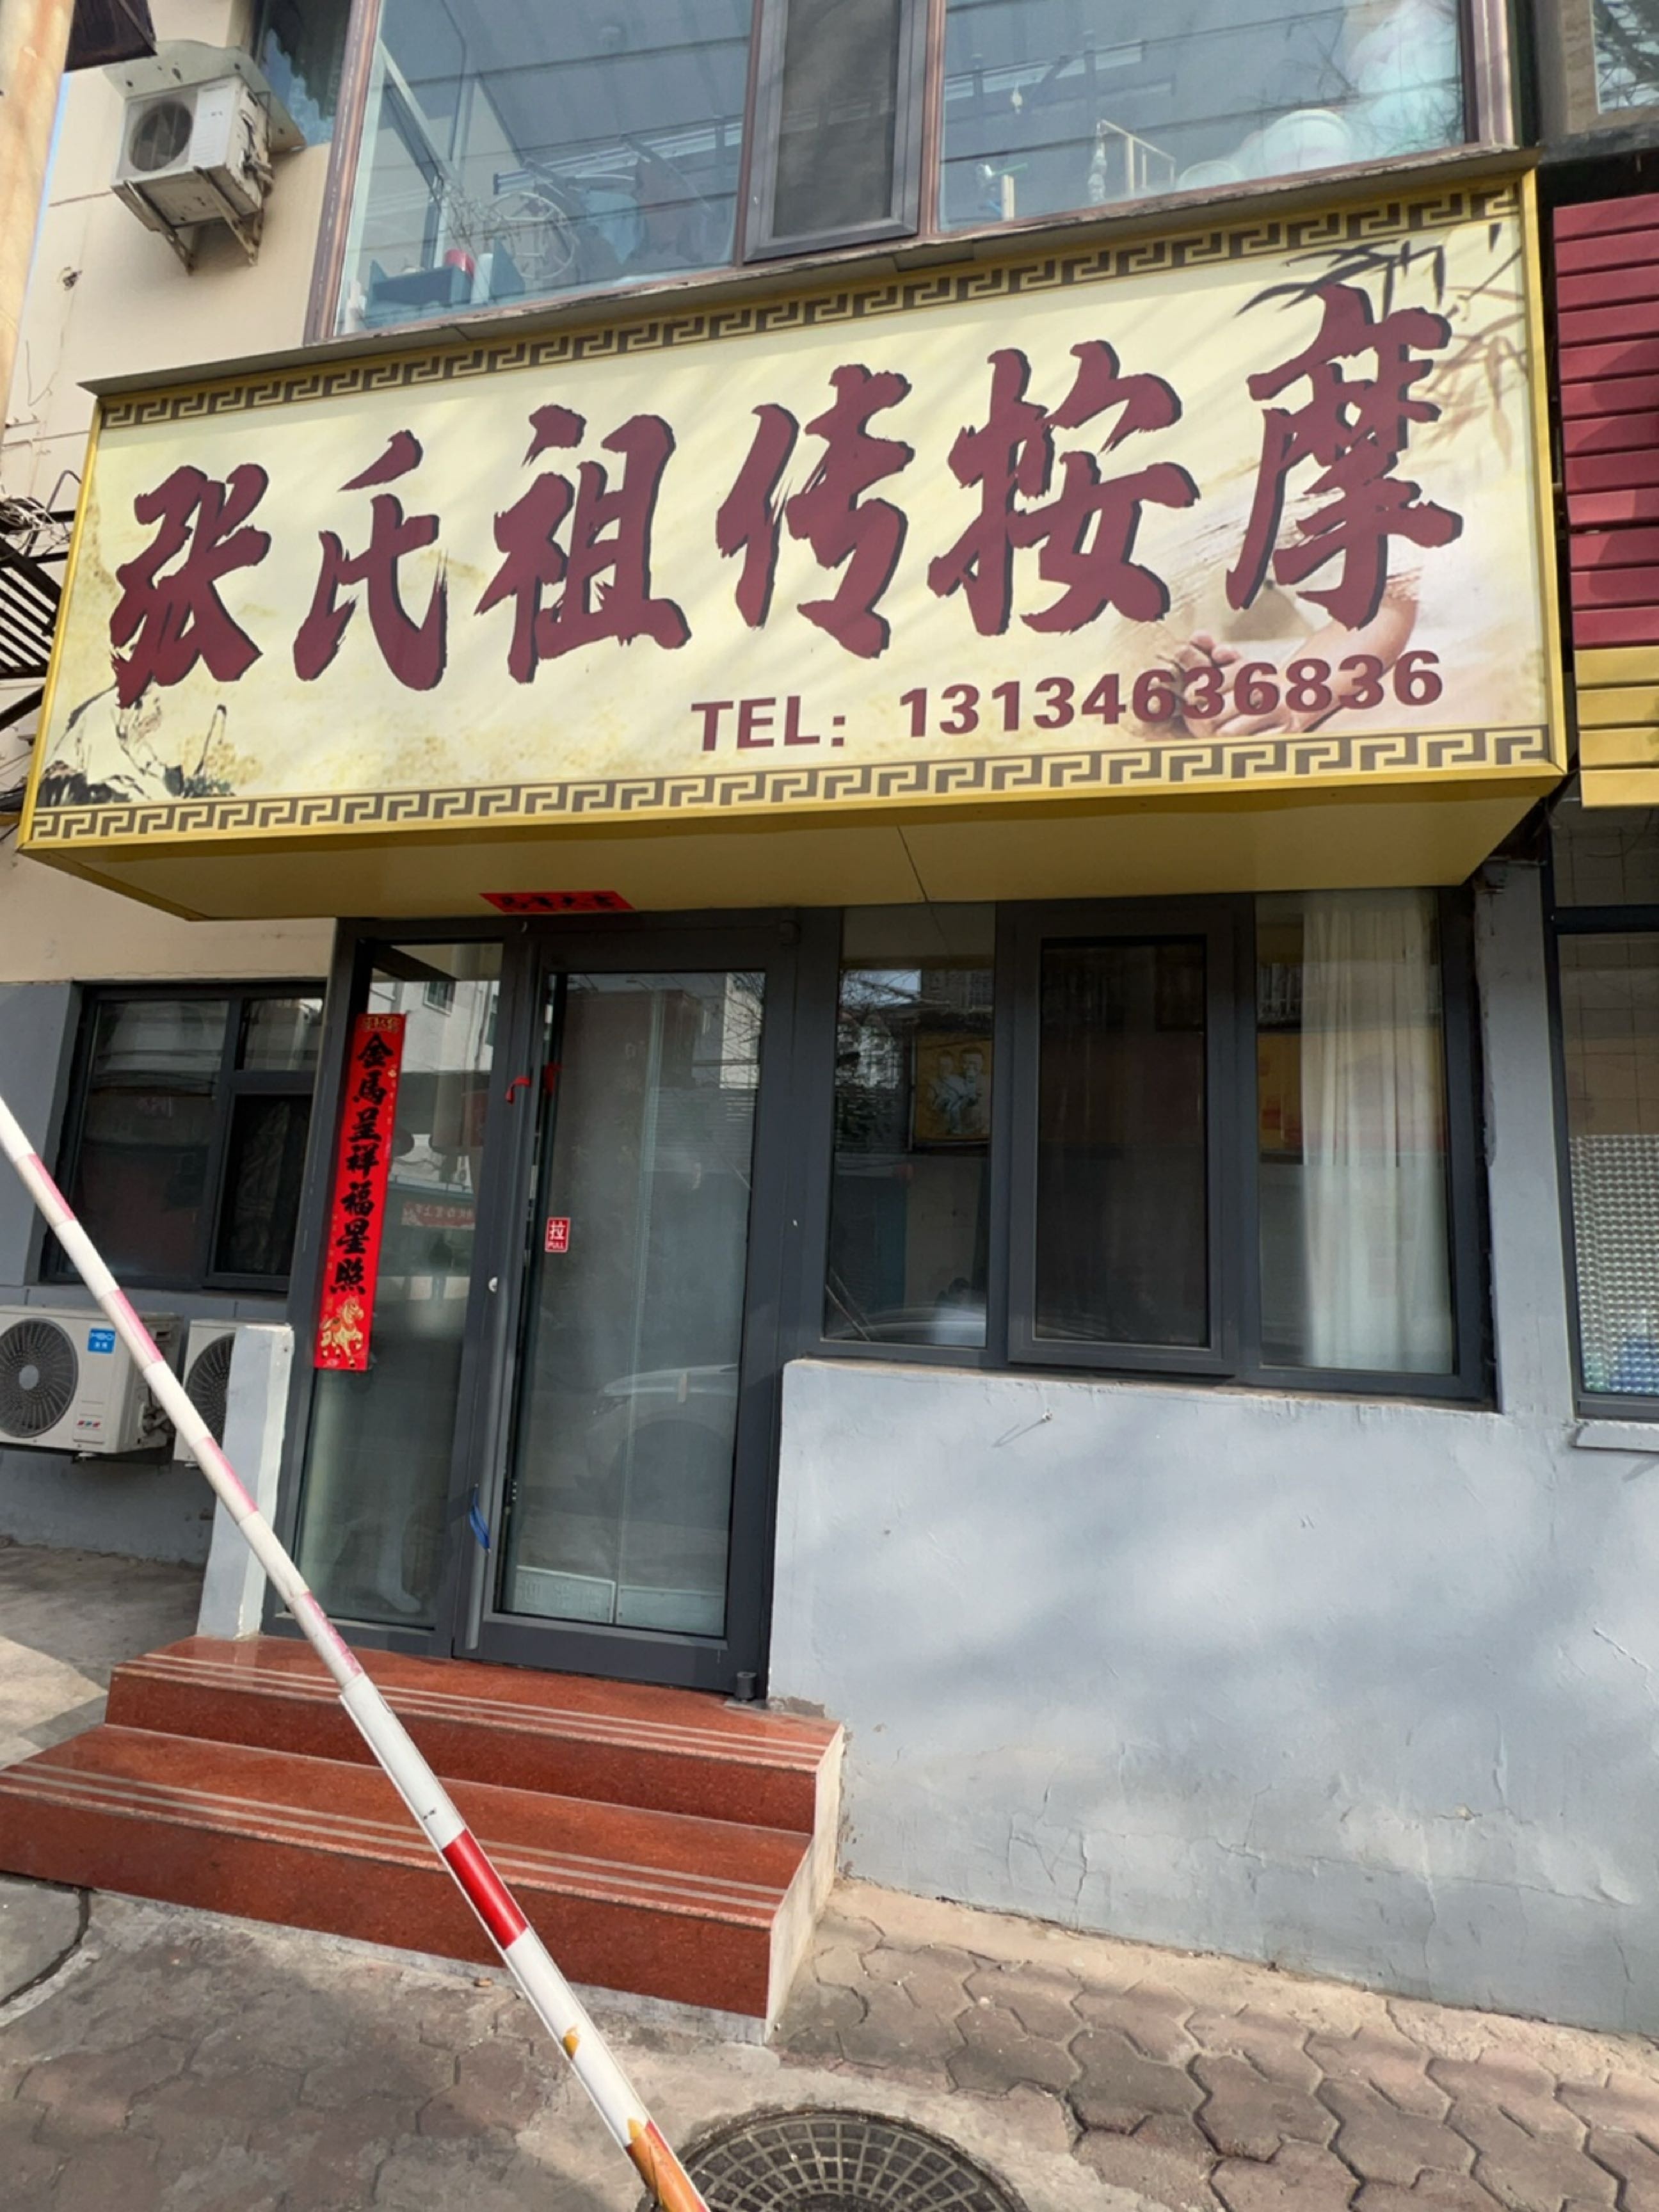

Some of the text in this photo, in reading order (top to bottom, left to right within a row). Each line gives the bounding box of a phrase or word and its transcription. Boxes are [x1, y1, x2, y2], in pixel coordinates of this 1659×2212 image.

[109, 283, 1464, 709] 张氏祖传按摩
[899, 649, 1444, 738] 13134636836
[547, 1240, 565, 1249] PULL
[549, 1220, 566, 1240] 拉
